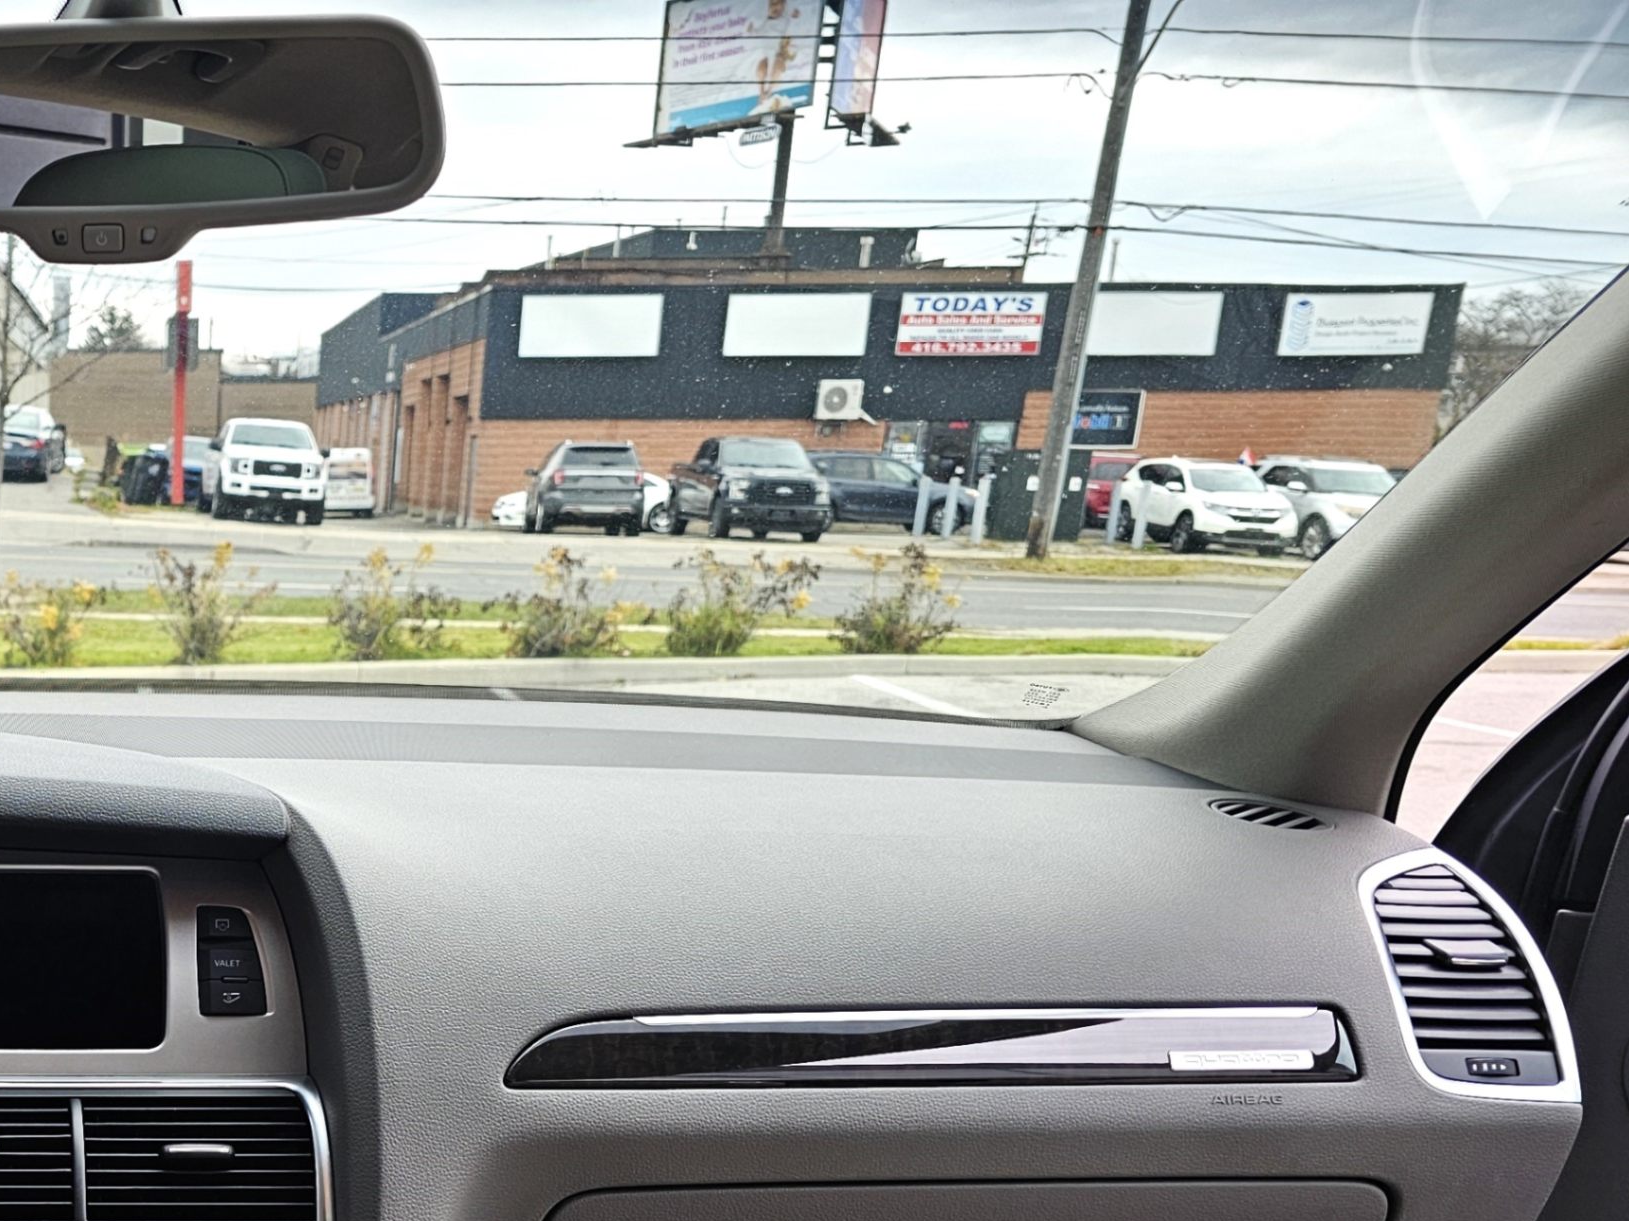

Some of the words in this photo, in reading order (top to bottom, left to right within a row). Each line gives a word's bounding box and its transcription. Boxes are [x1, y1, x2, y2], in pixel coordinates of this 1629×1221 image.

[915, 297, 1034, 312] TODAY'S
[907, 315, 934, 325] Auto
[936, 315, 967, 325] Sales
[994, 315, 1038, 325] Service
[214, 959, 241, 967] VALET
[1211, 1094, 1284, 1105] AIRBAG
